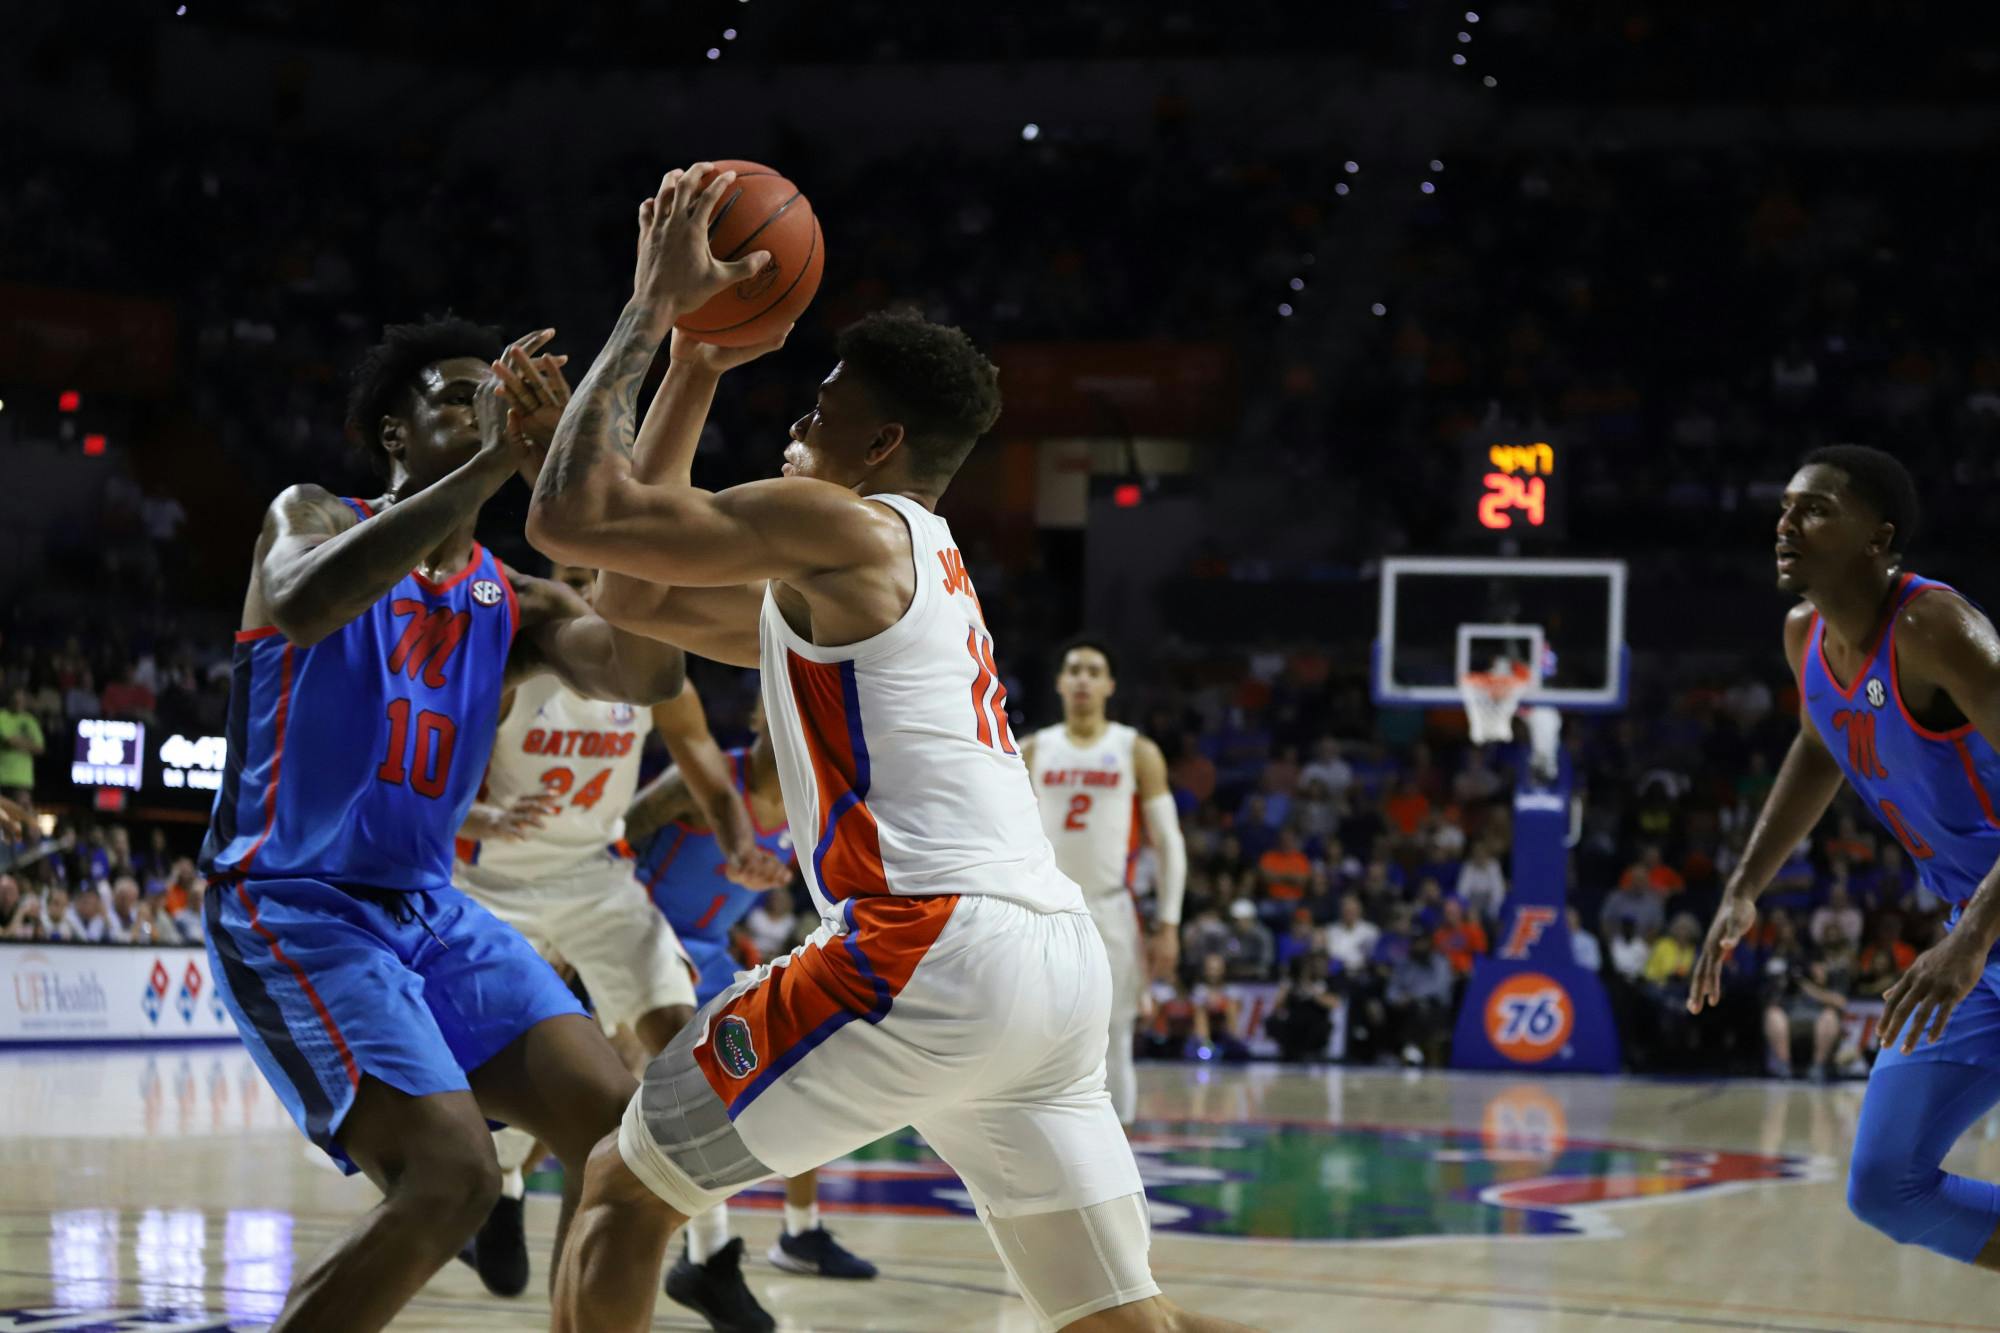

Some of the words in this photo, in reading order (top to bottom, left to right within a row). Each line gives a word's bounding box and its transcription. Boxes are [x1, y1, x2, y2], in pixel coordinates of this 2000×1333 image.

[1478, 472, 1546, 529] 24
[472, 581, 502, 604] SEC
[377, 697, 457, 799] 10
[522, 728, 636, 758] GATORS
[541, 766, 613, 814] 24
[1064, 792, 1093, 832] 2
[694, 894, 728, 929] 1
[1500, 905, 1557, 960] F
[1497, 988, 1562, 1045] 76
